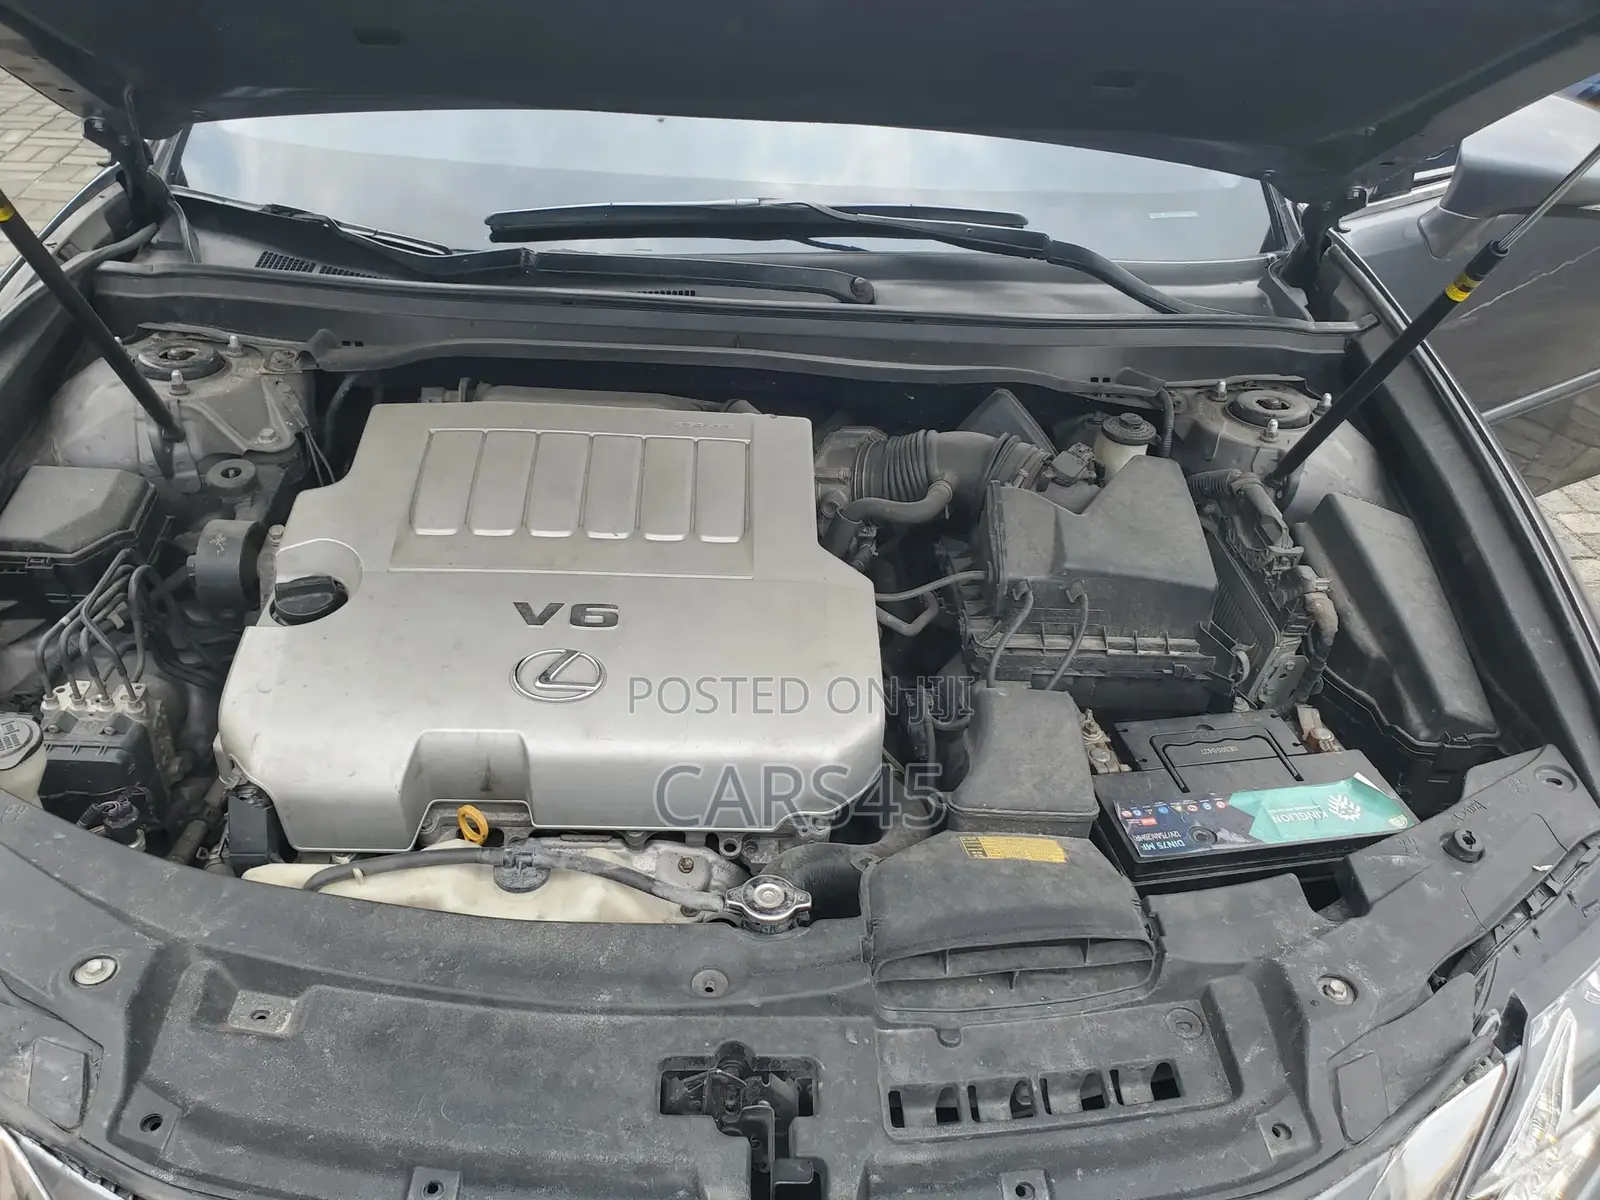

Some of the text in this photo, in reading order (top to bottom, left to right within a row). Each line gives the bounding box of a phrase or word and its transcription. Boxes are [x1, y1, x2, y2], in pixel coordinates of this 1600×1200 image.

[512, 601, 619, 629] V6
[1272, 809, 1329, 823] KINGLION
[1141, 839, 1186, 851] DIN75 MF
